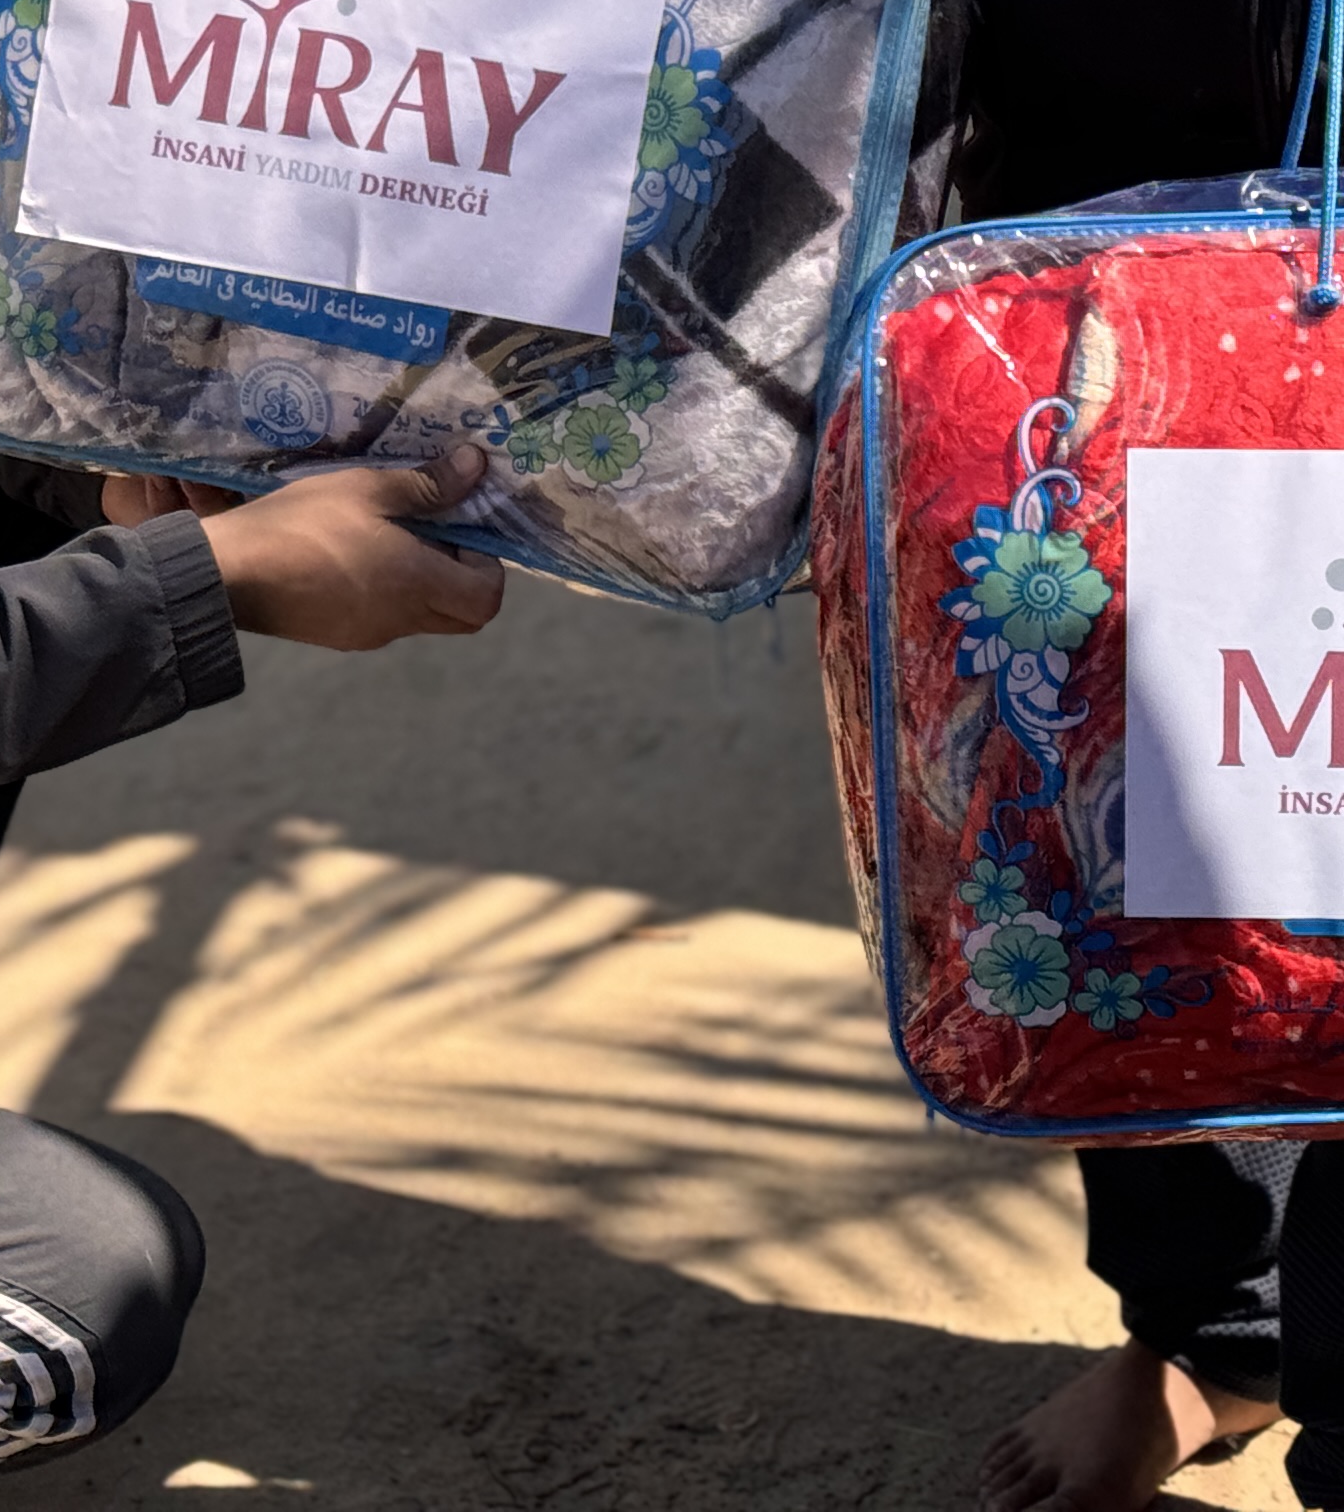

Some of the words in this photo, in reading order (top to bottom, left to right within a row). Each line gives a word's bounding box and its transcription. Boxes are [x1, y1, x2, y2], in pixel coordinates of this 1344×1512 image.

[150, 129, 247, 173] İNSANİ
[256, 153, 353, 192] YARDIM
[358, 171, 491, 217] DERNEĞİ
[392, 310, 436, 349] رواد
